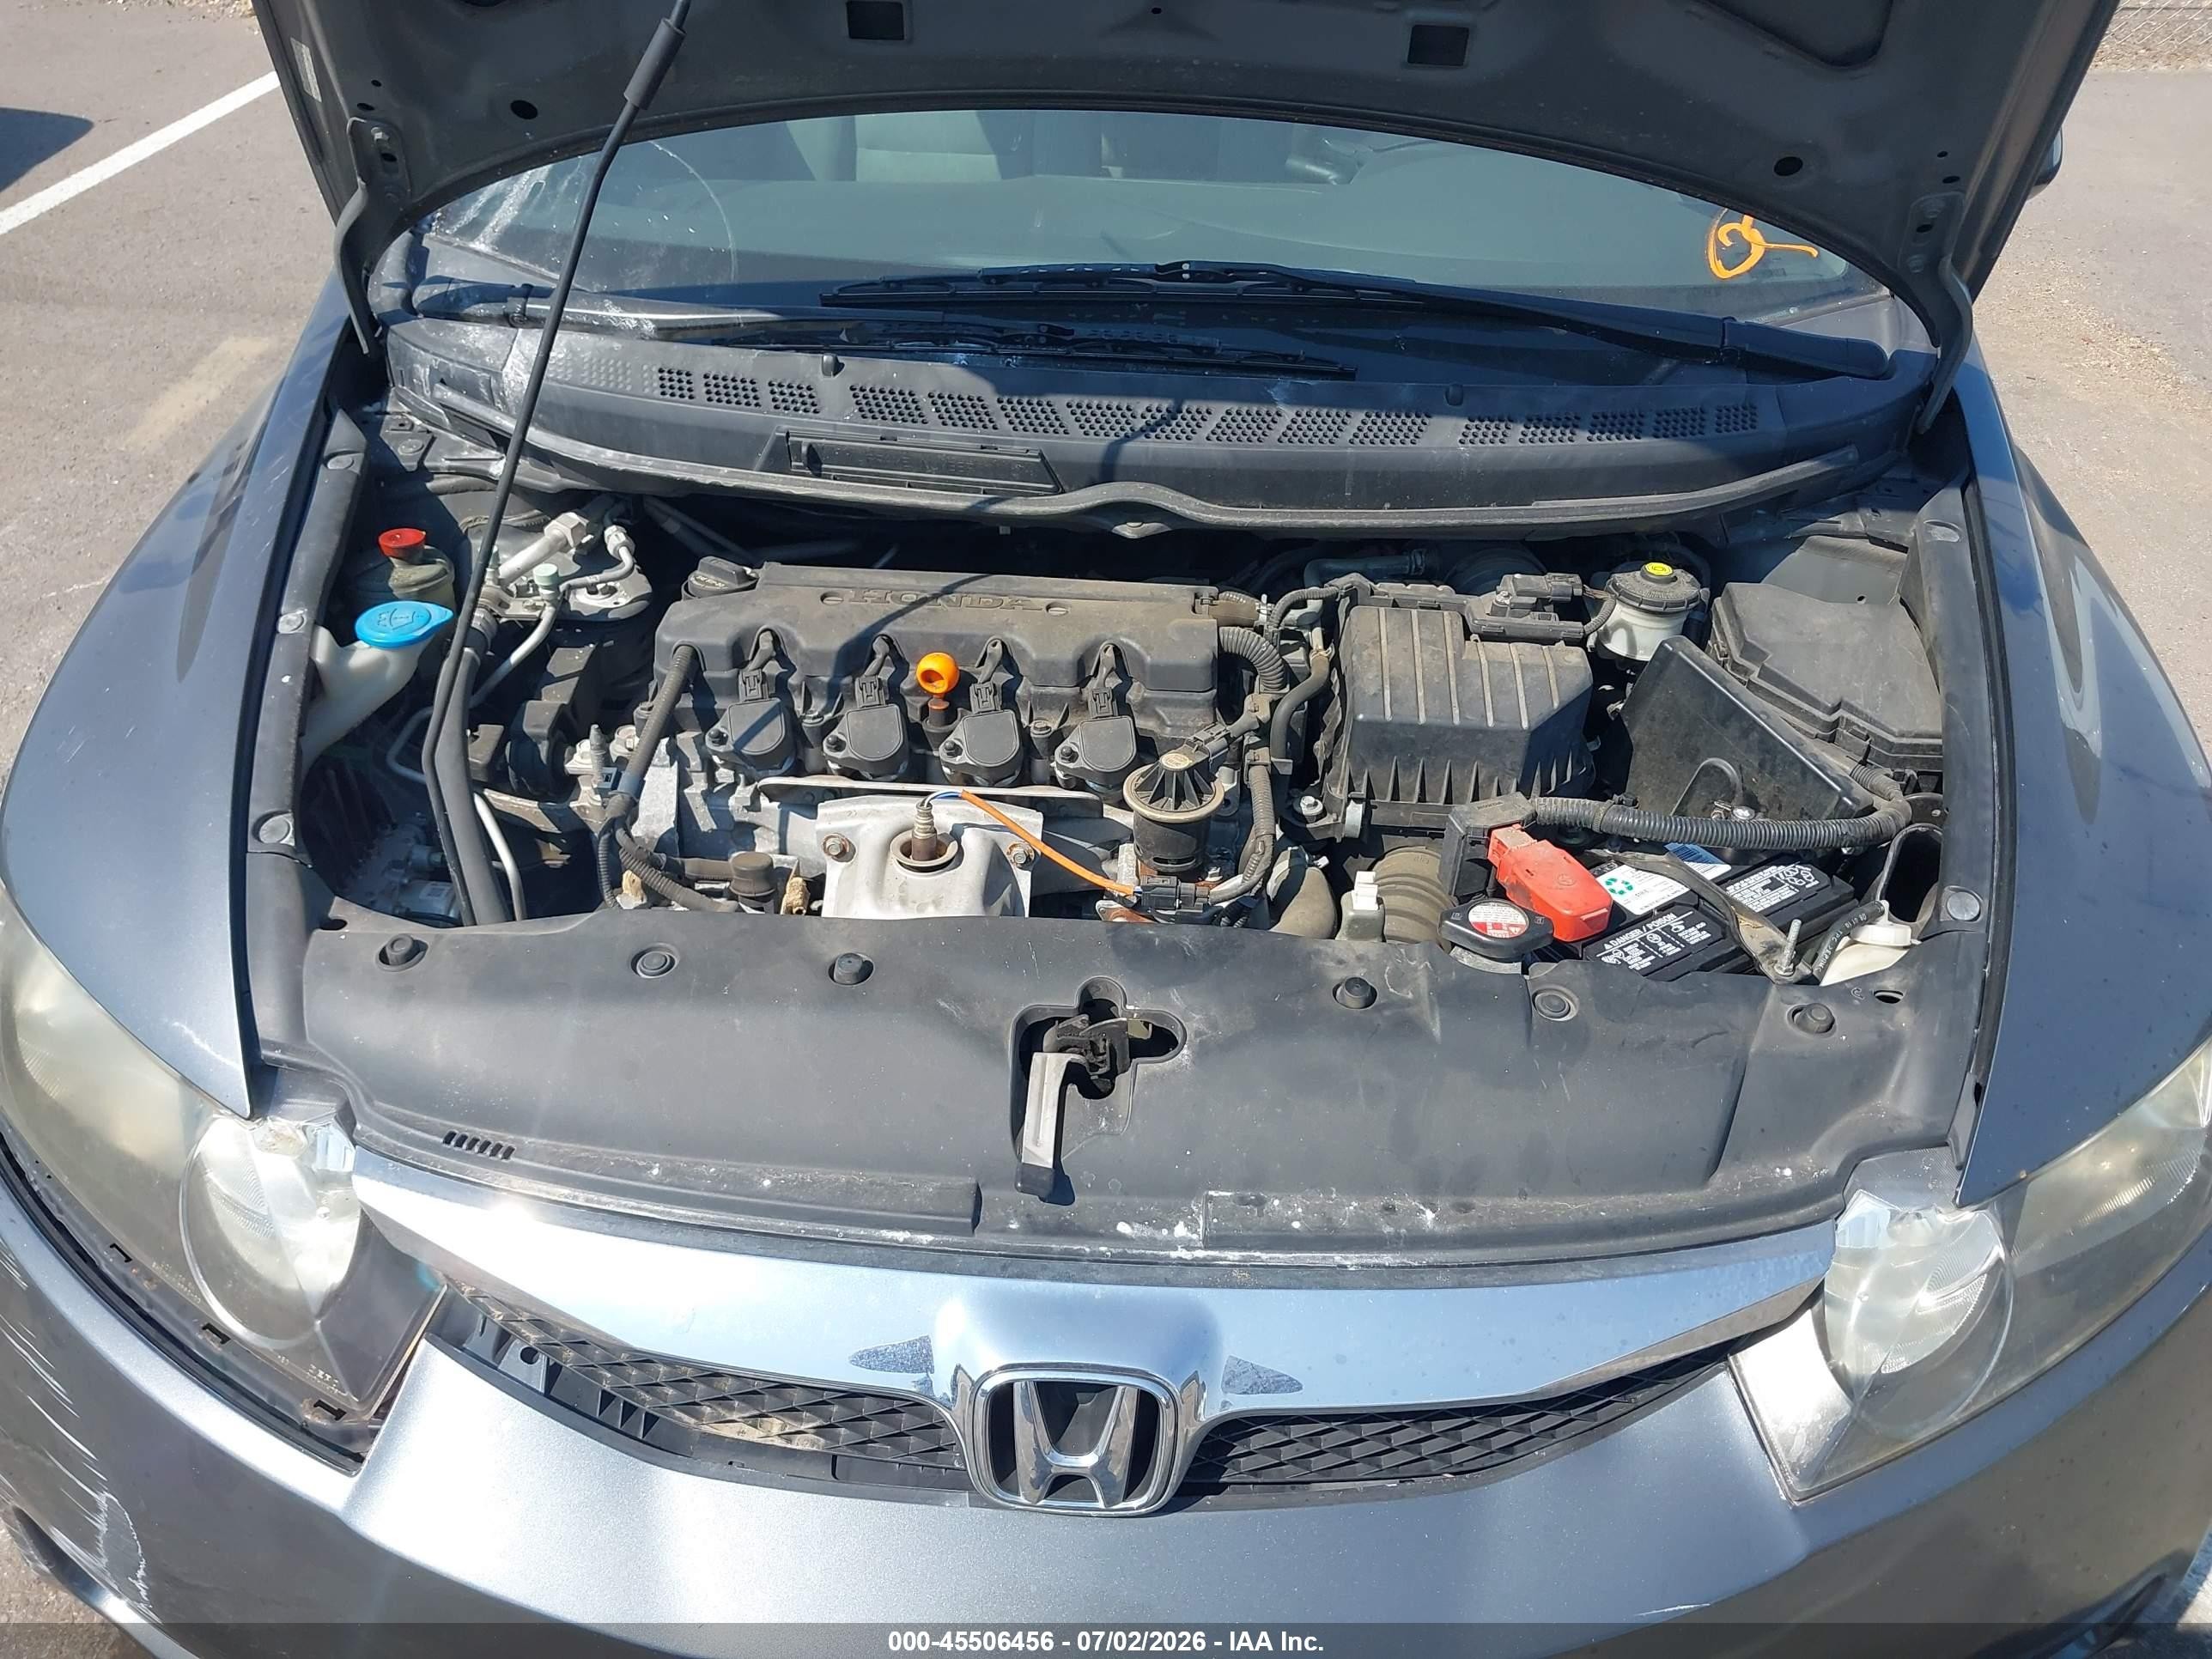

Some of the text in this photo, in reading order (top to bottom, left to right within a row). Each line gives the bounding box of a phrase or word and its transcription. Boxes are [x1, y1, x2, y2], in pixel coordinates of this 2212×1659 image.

[848, 588, 1042, 611] HONDA
[1609, 928, 1644, 947] DANGER
[1645, 912, 1677, 930] POISON
